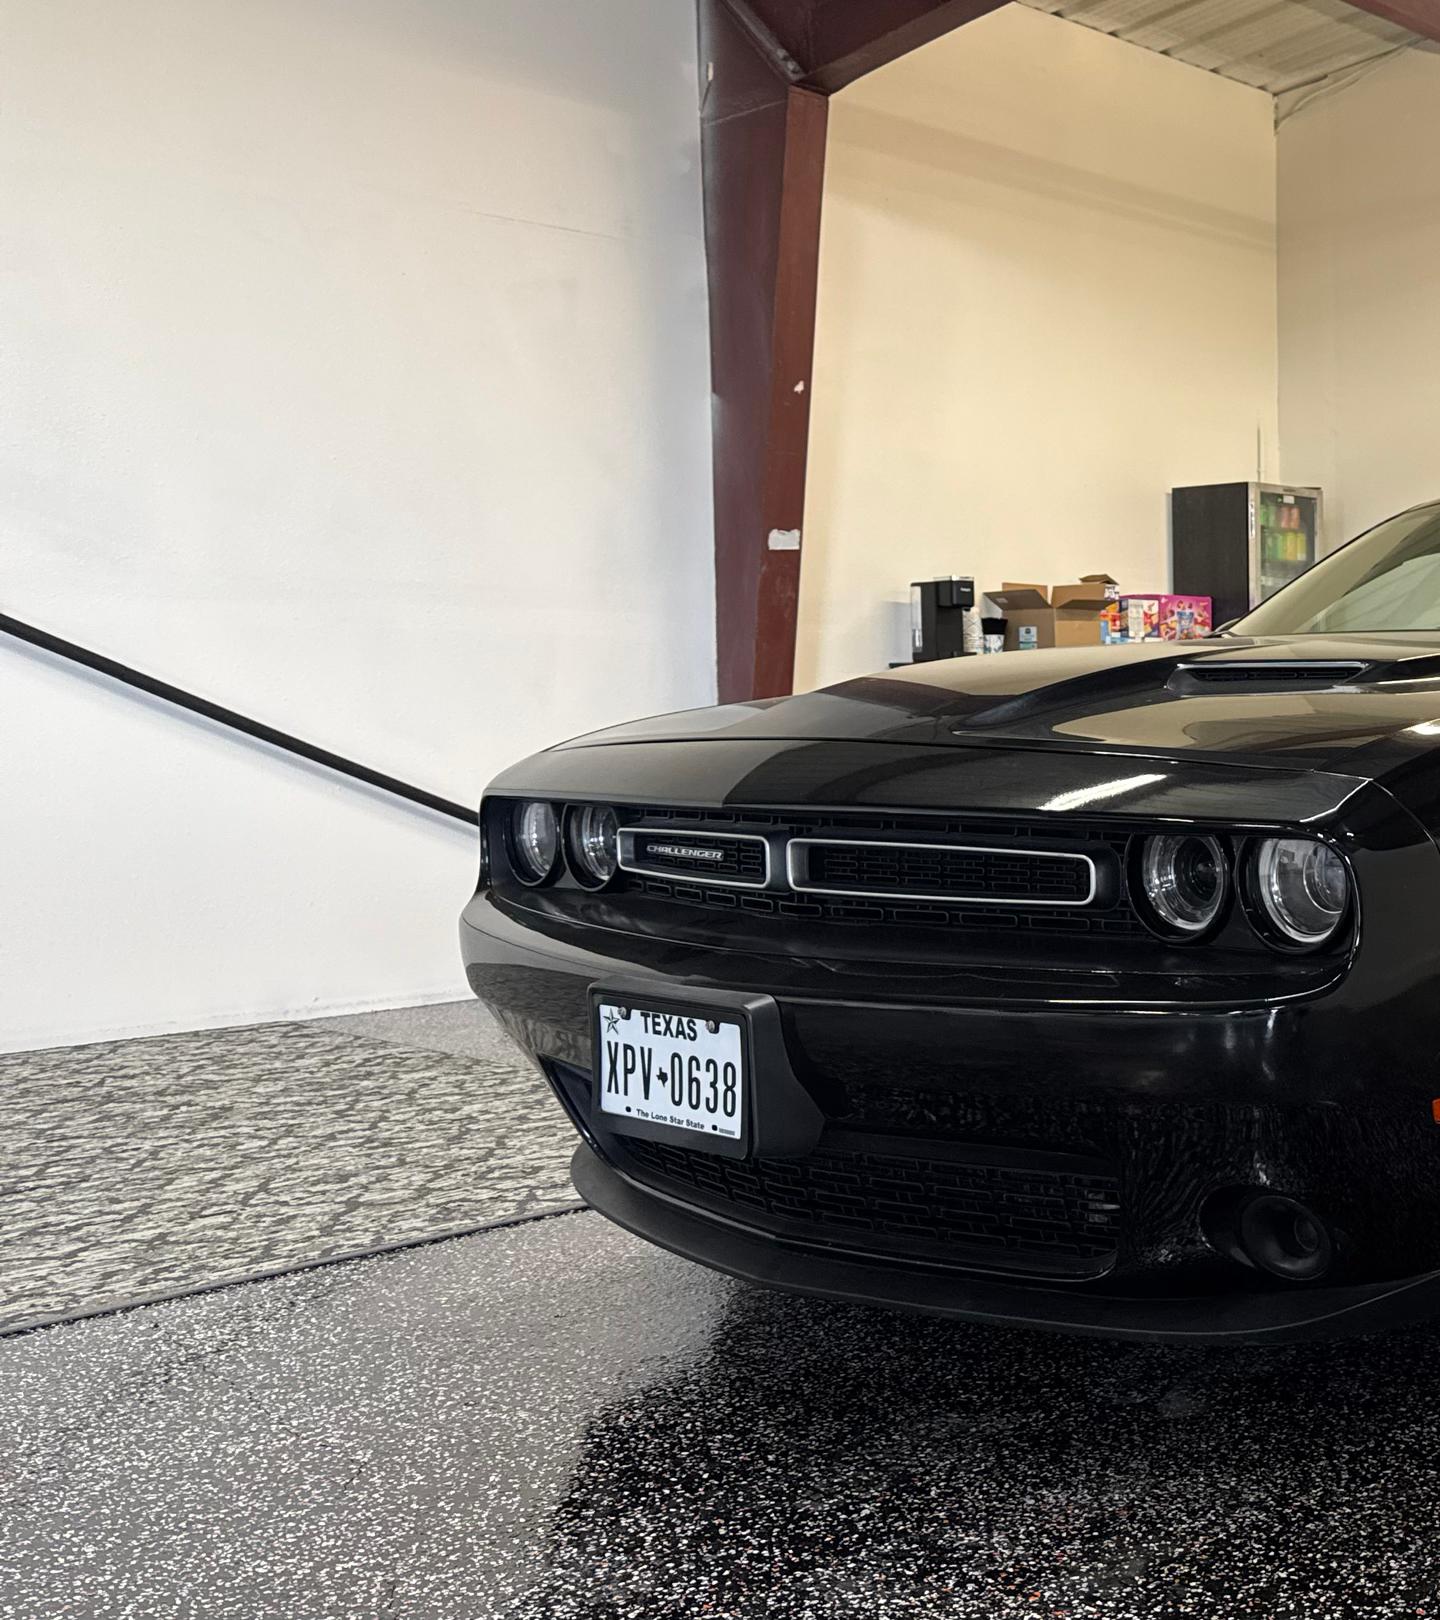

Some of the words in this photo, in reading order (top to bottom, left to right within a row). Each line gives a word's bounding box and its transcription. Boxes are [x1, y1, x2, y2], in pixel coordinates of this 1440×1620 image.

[646, 845, 723, 860] CHALLENGER
[640, 1012, 698, 1042] TEXAS
[636, 1108, 649, 1118] The
[651, 1112, 668, 1122] Lone
[669, 1115, 684, 1126] Star
[686, 1118, 705, 1130] State
